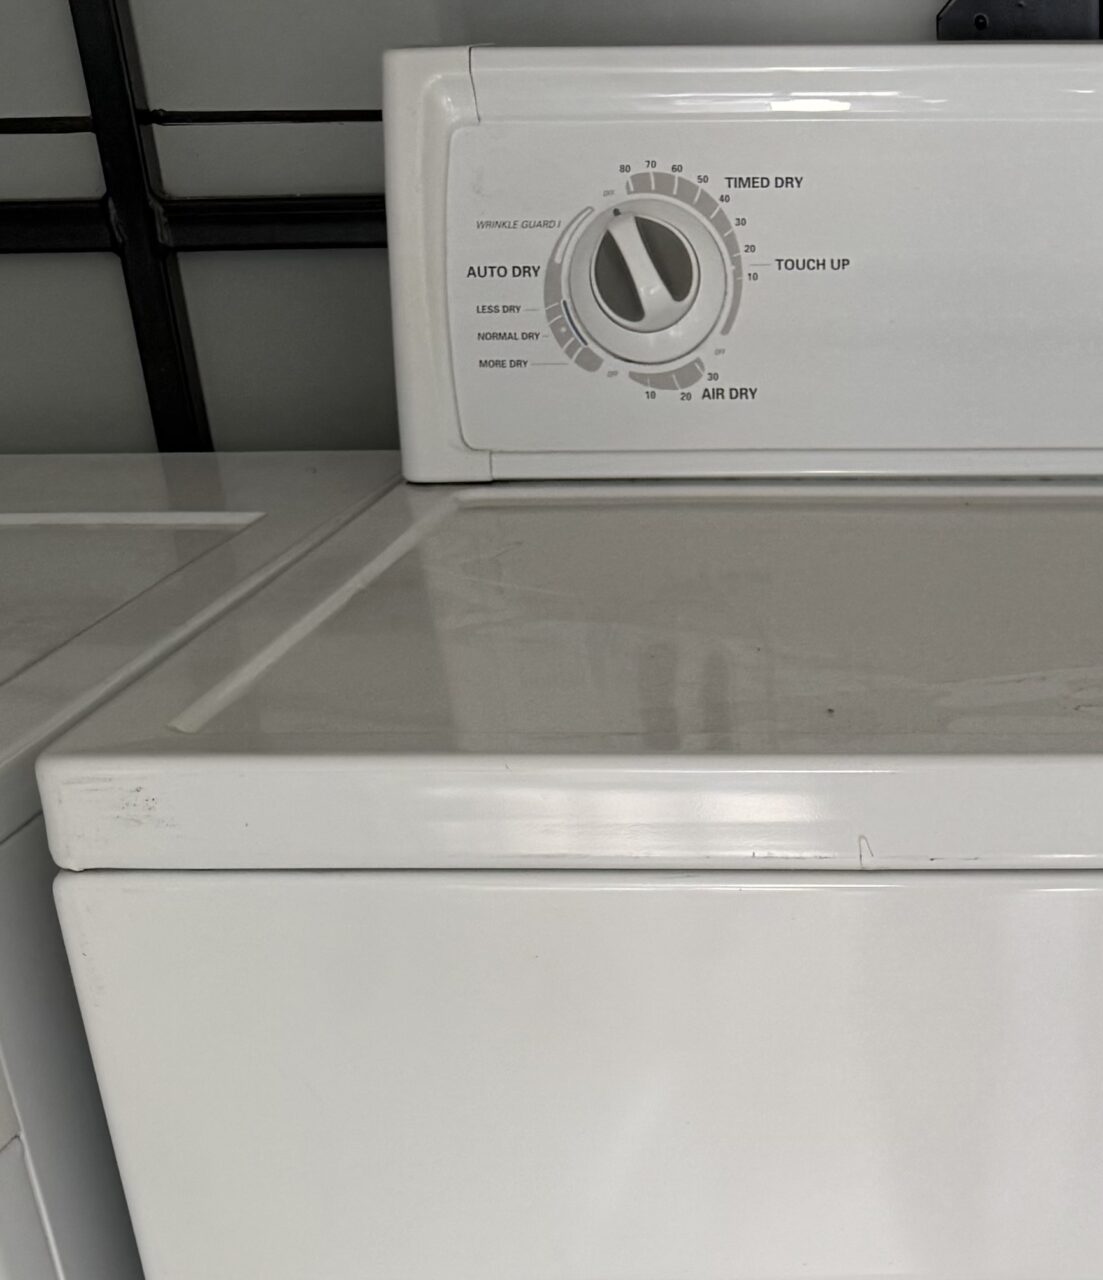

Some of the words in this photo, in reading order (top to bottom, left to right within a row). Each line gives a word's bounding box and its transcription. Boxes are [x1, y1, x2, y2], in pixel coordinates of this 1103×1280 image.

[619, 165, 631, 173] 80
[645, 160, 657, 169] 70
[671, 164, 683, 173] 60
[697, 175, 709, 184] 50
[725, 177, 770, 188] TIMED
[775, 177, 803, 188] DRY
[719, 194, 730, 203] 40
[476, 220, 519, 229] WRINKLE
[522, 220, 555, 229] GUARD
[735, 218, 746, 226] 30
[744, 244, 756, 253] 20
[776, 259, 826, 270] TOUCH
[830, 259, 850, 270] UP
[467, 265, 507, 278] AUTO
[512, 265, 541, 278] DRY
[748, 273, 758, 281] 10
[476, 305, 499, 314] LESS
[502, 305, 522, 314] DRY
[478, 332, 518, 341] NORMAL
[520, 332, 541, 341] DRY
[479, 360, 506, 368] MORE
[509, 360, 528, 368] DRY
[707, 372, 719, 381] 30
[646, 391, 656, 399] 10
[680, 392, 692, 401] 20
[702, 388, 725, 400] AIR
[730, 388, 757, 400] DRY
